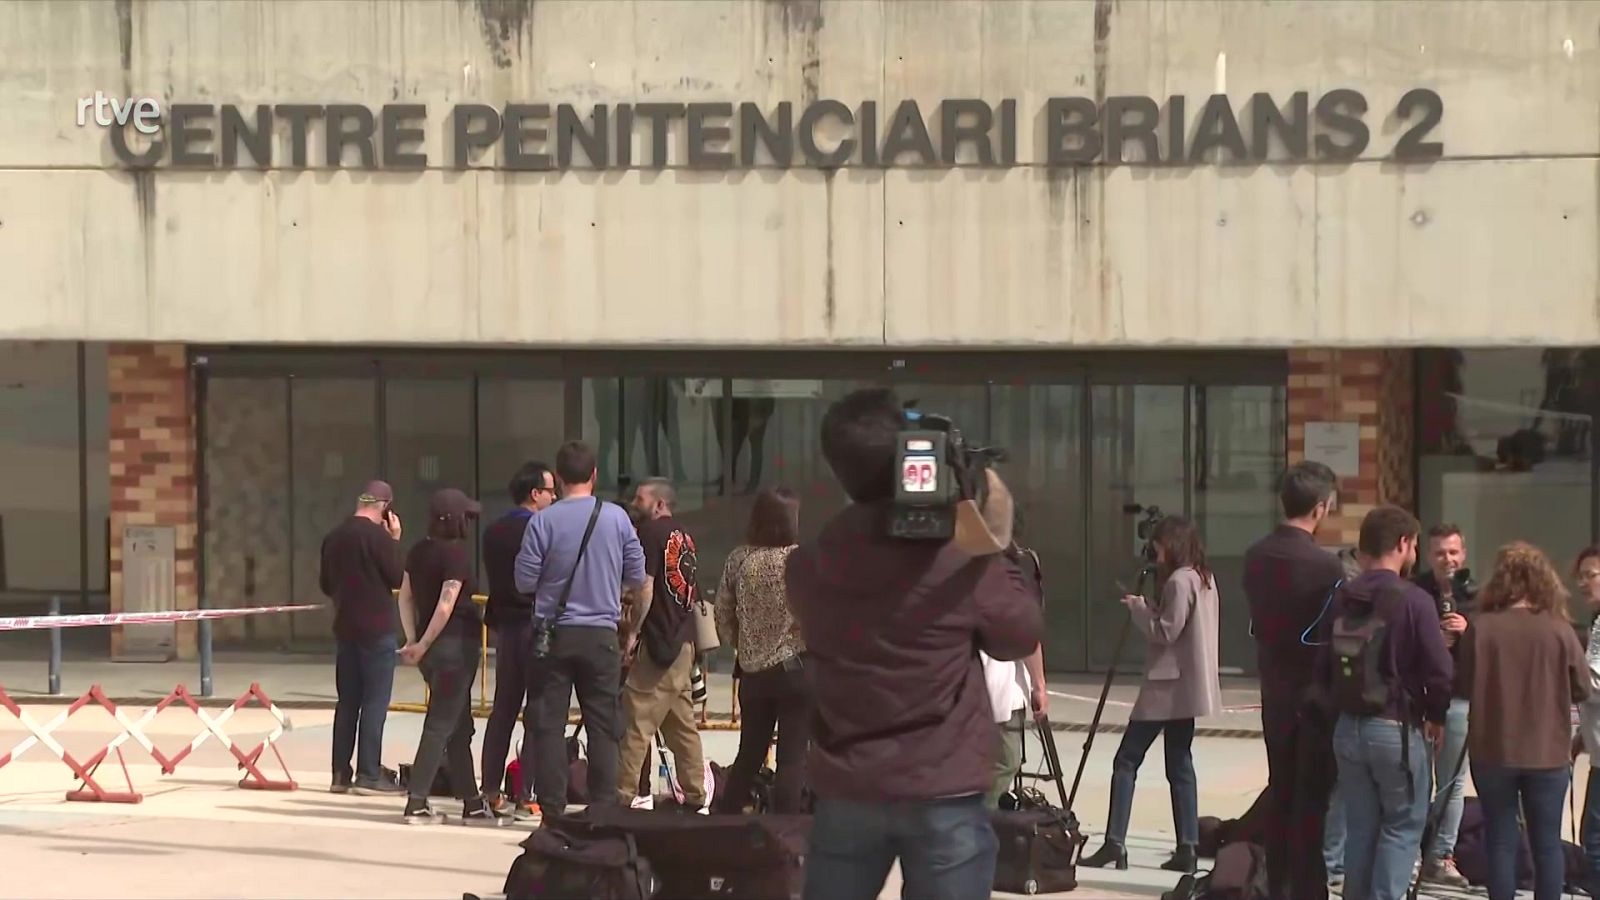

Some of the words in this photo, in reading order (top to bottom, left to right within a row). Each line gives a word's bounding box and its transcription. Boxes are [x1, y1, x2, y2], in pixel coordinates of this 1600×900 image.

[454, 98, 1016, 169] PENITENCIARI
[1047, 88, 1369, 164] BRIANS
[1394, 88, 1443, 157] 2
[904, 463, 932, 490] ep
[1442, 602, 1451, 612] 3
